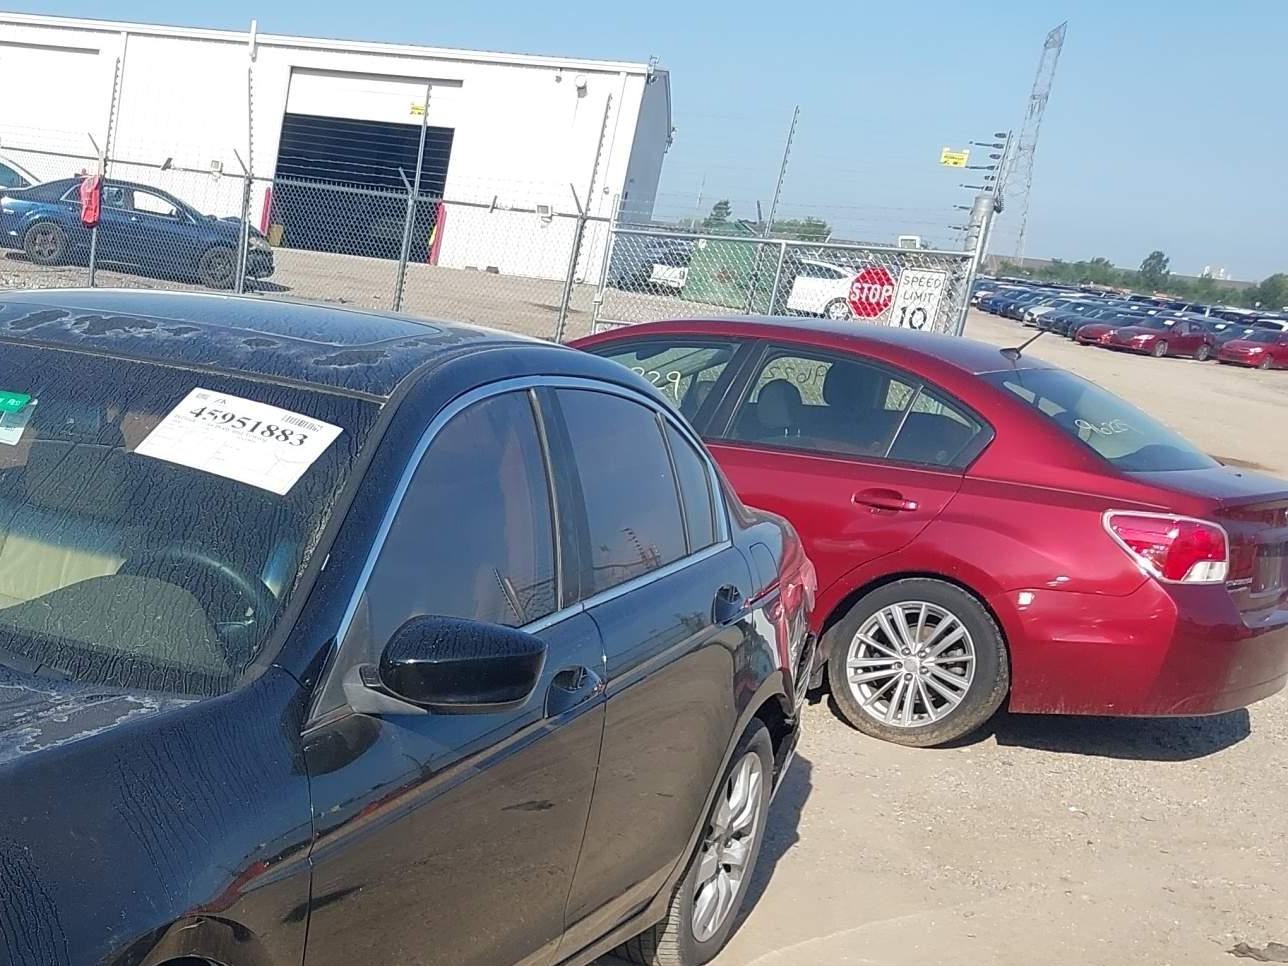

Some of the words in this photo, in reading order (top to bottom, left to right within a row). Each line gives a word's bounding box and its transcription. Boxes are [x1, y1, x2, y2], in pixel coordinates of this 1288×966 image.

[851, 282, 893, 304] STOP
[903, 275, 942, 289] SPEED
[903, 290, 935, 303] LIMIT
[898, 306, 928, 330] 10
[189, 405, 309, 447] 45951883
